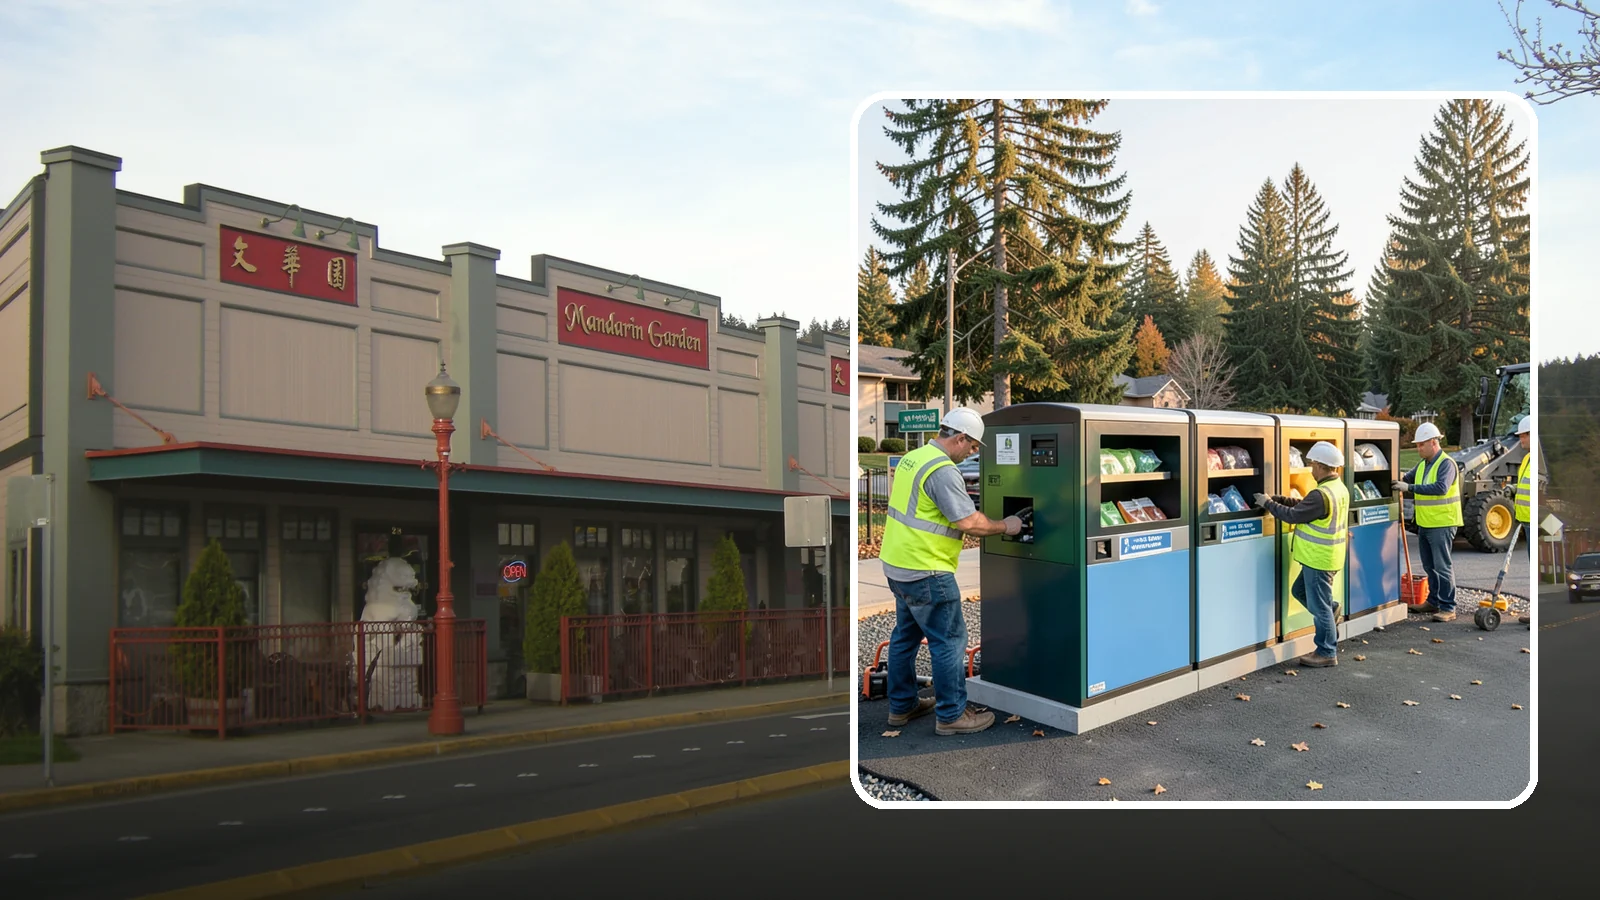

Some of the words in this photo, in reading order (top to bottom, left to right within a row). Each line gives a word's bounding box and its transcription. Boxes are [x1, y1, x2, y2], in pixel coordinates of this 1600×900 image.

[230, 235, 346, 291] 文華園
[564, 302, 644, 341] Mandarin
[648, 320, 701, 352] Garden
[503, 565, 527, 578] OPEN
